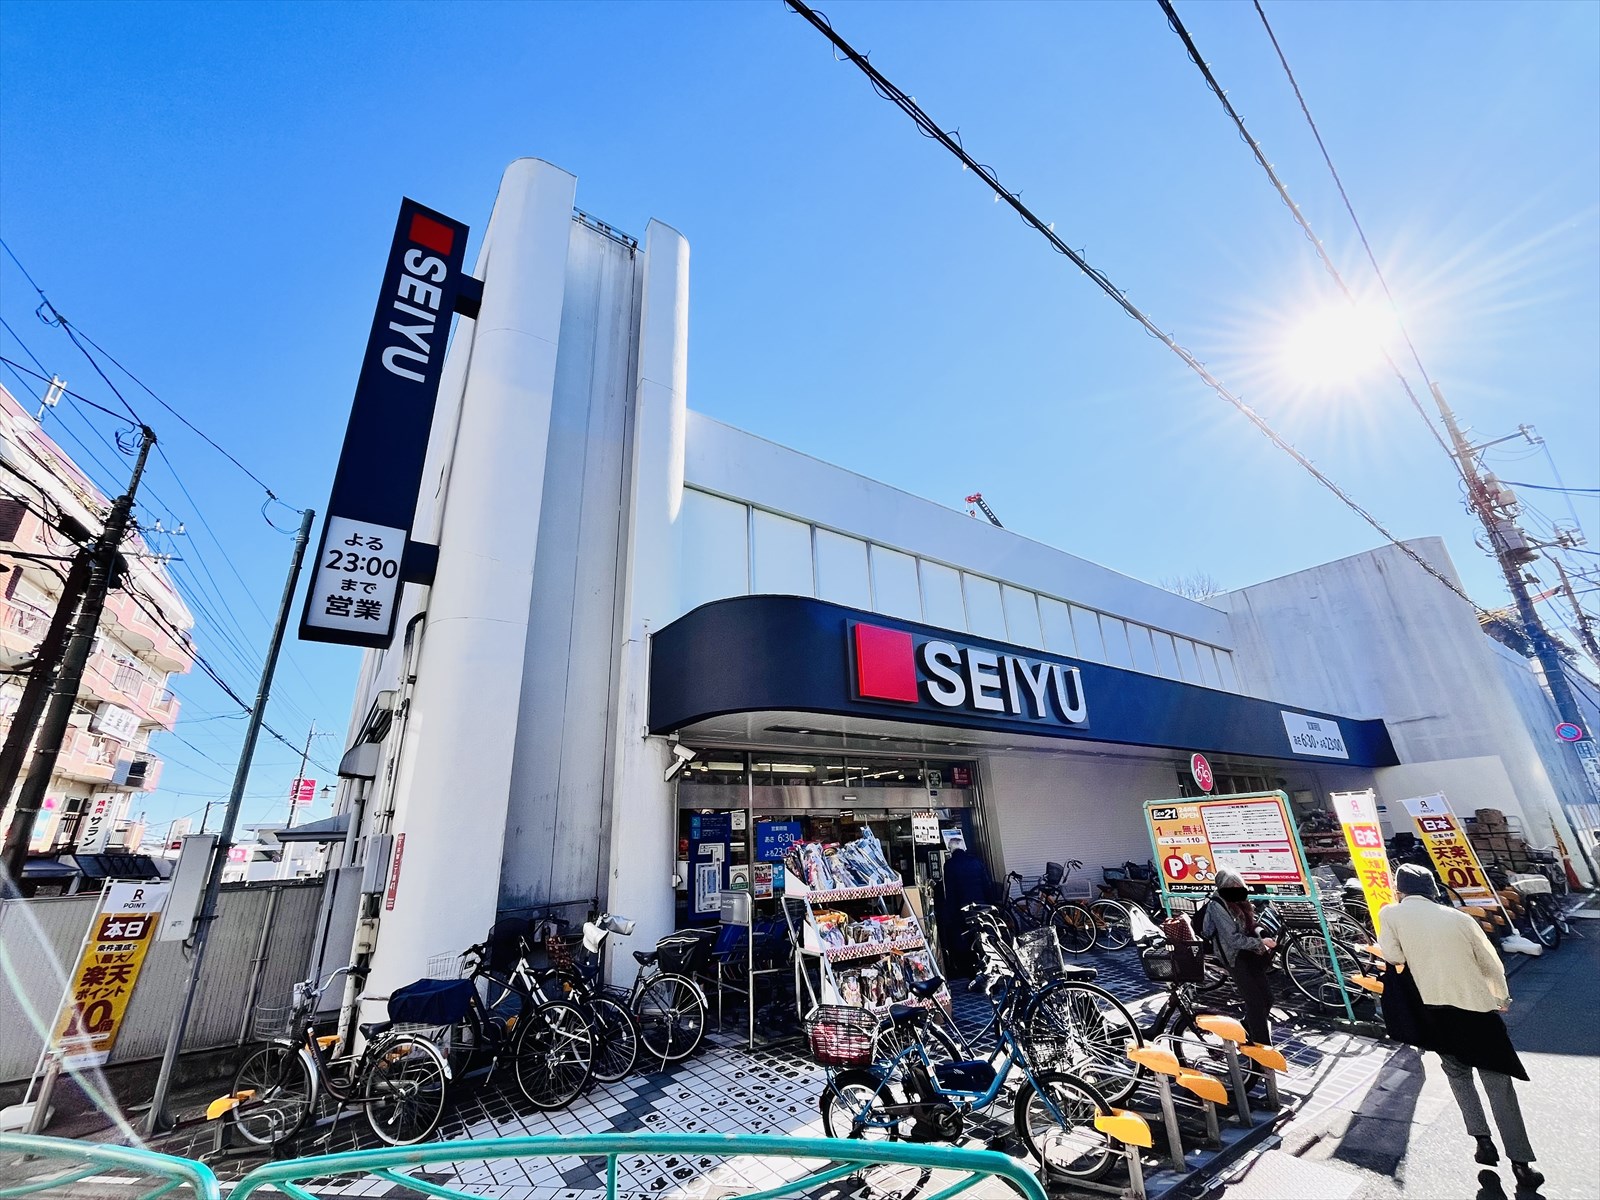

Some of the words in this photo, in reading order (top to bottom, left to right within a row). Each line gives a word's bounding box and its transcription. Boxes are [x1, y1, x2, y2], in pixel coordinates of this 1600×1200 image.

[382, 248, 447, 383] SEIYU
[344, 532, 384, 551] よる
[325, 549, 398, 579] 23:00
[340, 578, 377, 595] まで
[325, 594, 382, 621] 営業
[919, 639, 1088, 724] SEIYU
[132, 889, 144, 900] R
[103, 921, 145, 939] 本日
[97, 943, 138, 952] 条件達成で
[80, 964, 135, 988] 楽天
[75, 985, 126, 1001] ポイント
